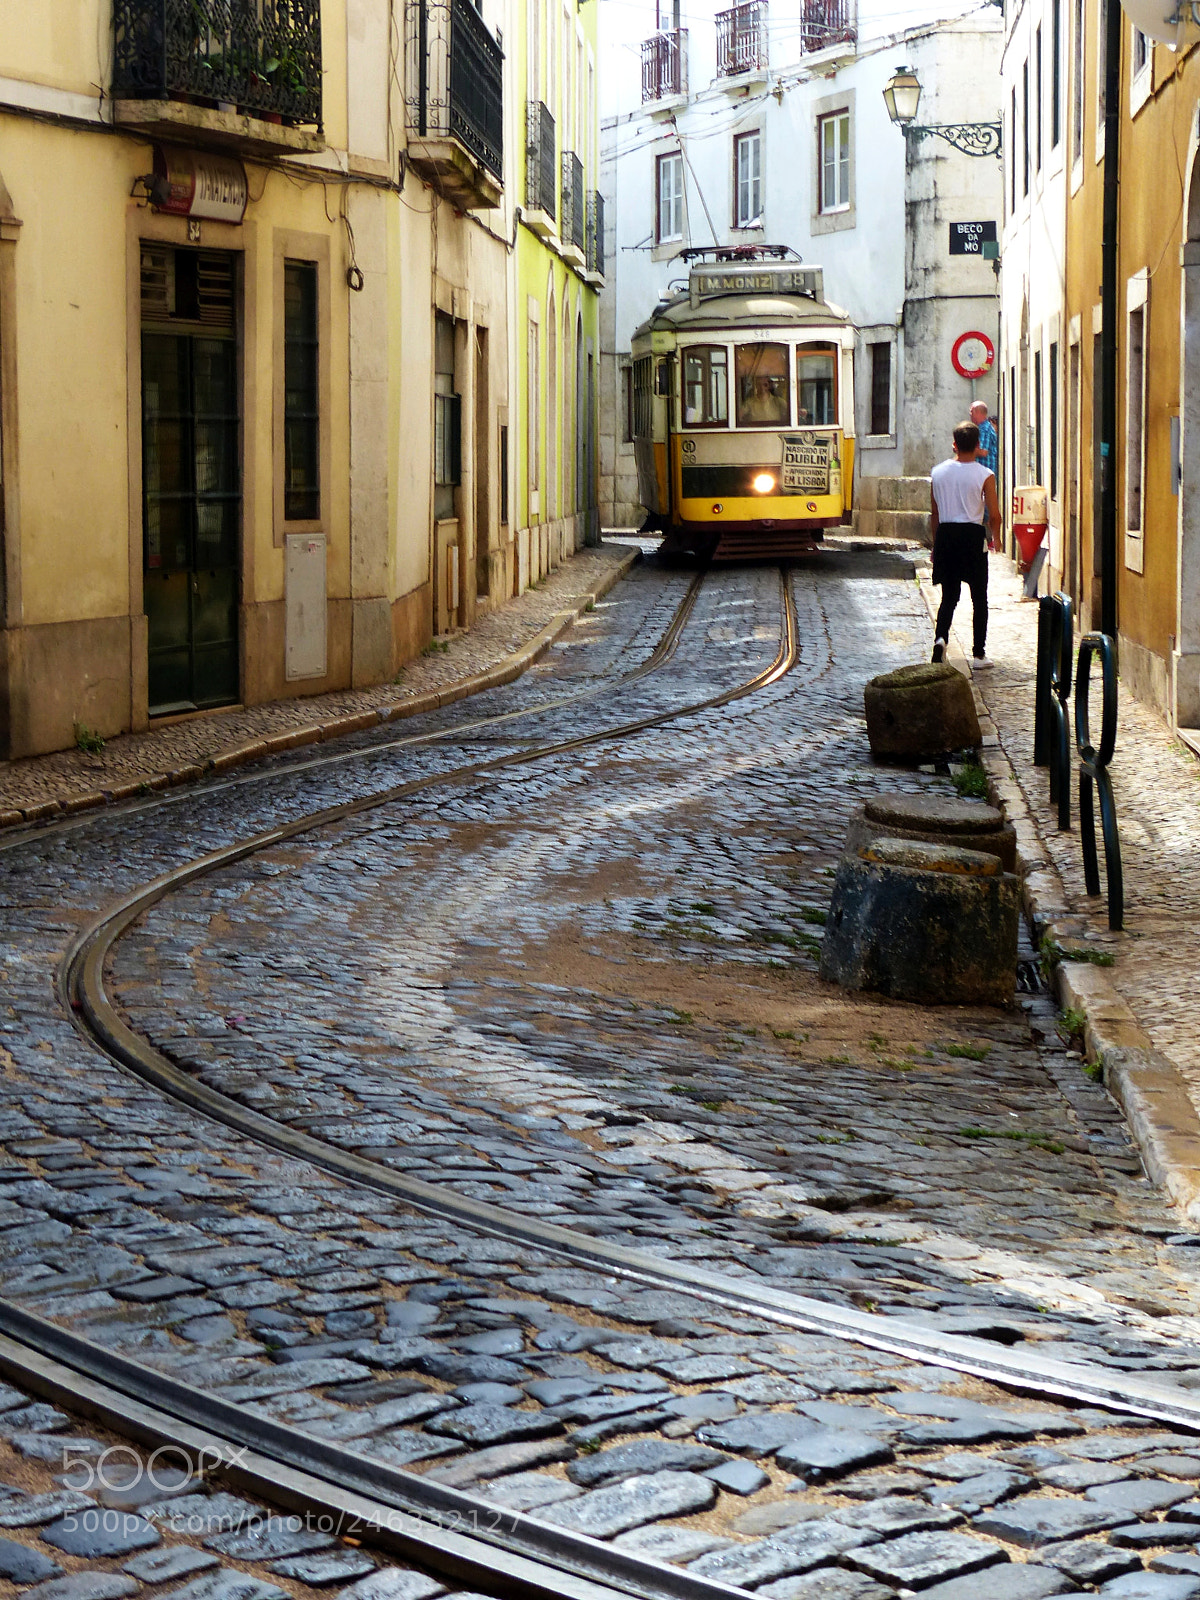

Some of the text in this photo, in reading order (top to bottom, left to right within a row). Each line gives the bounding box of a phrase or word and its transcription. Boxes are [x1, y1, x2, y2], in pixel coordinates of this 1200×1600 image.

[957, 223, 983, 233] BECO
[967, 233, 979, 241] DA
[723, 276, 770, 288] MONIZ
[783, 273, 805, 287] 28
[786, 446, 827, 455] NASCIDO EM
[786, 454, 827, 465] DUBLIN
[785, 475, 826, 486] EM LISBOA
